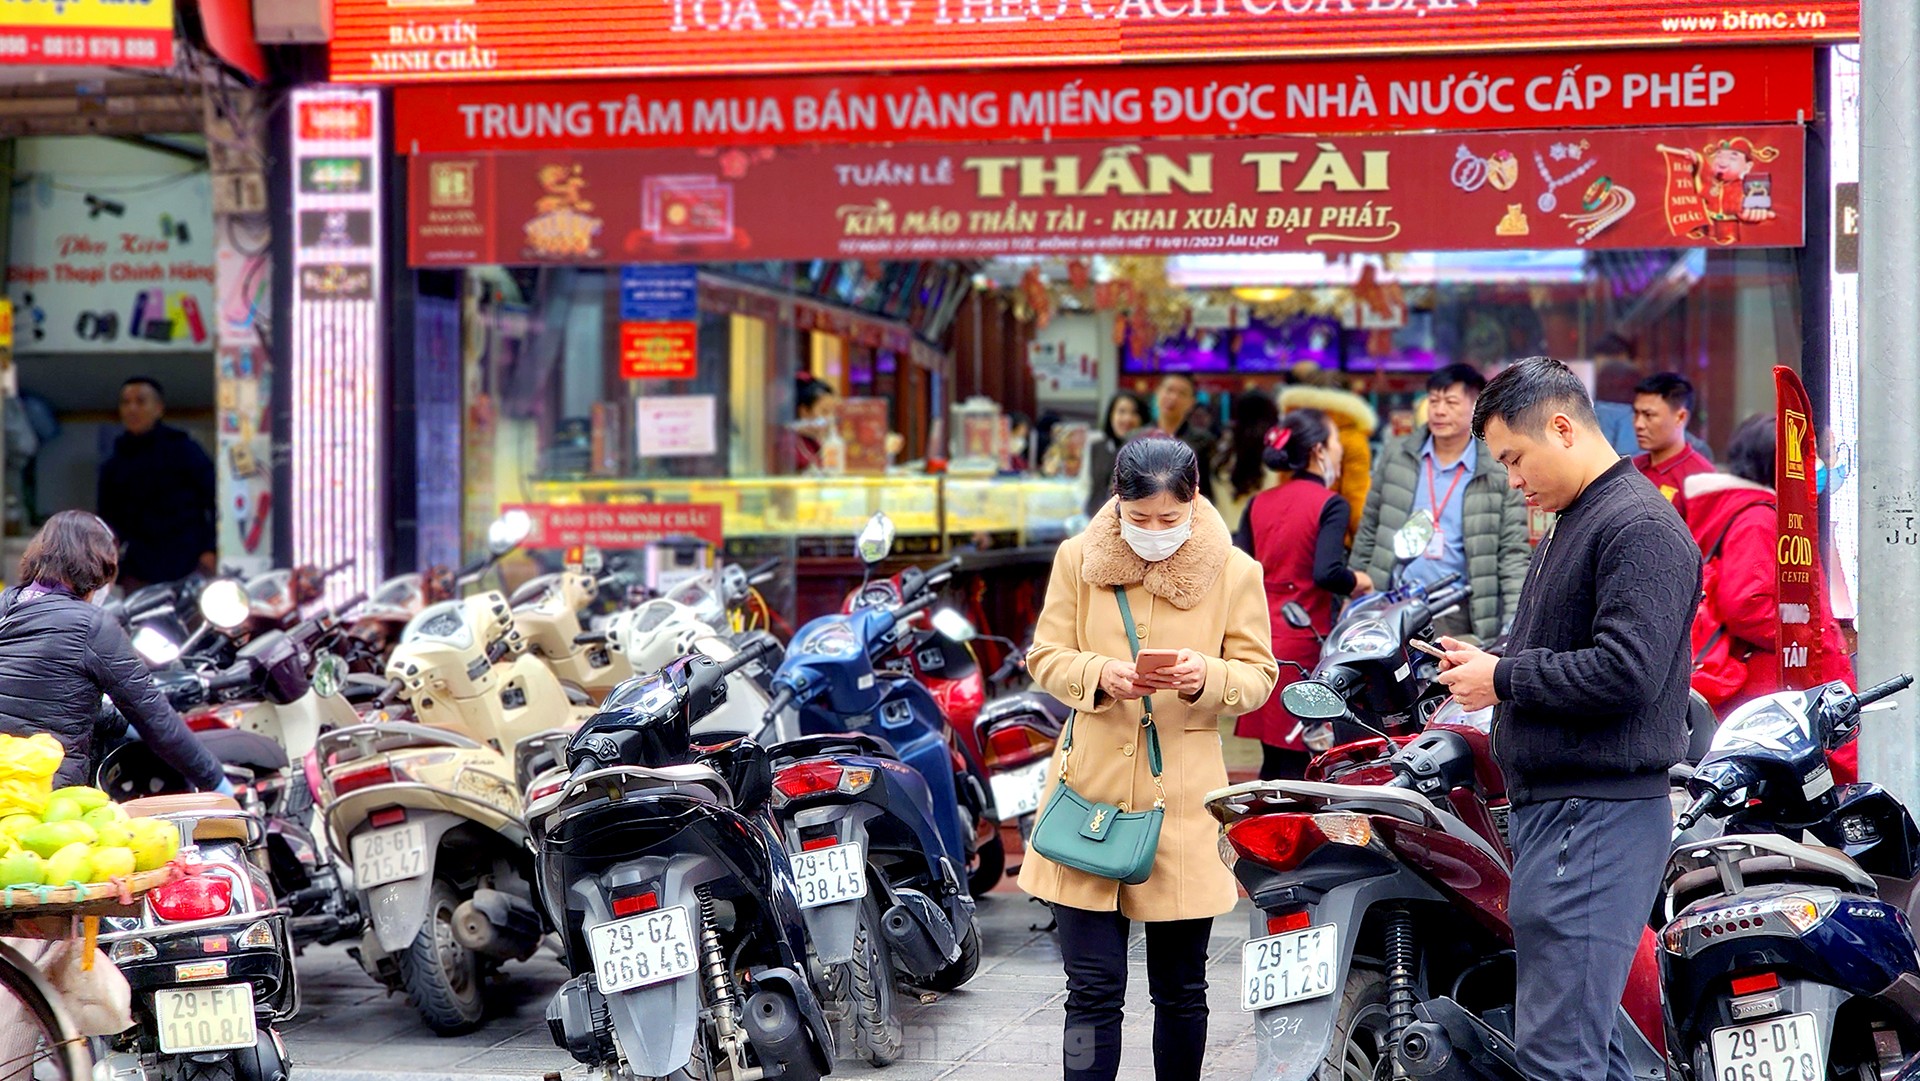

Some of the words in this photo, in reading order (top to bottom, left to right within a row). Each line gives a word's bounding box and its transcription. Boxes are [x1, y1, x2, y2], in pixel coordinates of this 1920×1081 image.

[438, 18, 478, 43] TÍN
[370, 51, 430, 71] MINH
[434, 44, 499, 69] CHÂU
[459, 102, 593, 138] TRUNG
[600, 94, 684, 136] TÂM
[693, 96, 784, 134] MUA
[793, 88, 877, 132] BÁN
[885, 86, 999, 128] VÀNG
[1009, 78, 1142, 126] MIẾNG
[1151, 82, 1275, 130] ĐƯỢC
[1287, 75, 1378, 118] NHÀ
[1390, 71, 1515, 114] NƯỚC
[1525, 64, 1612, 112] CẤP
[1623, 64, 1736, 108] PHÉP
[1241, 141, 1391, 192] TÀI
[1671, 195, 1699, 206] MINH
[1044, 203, 1086, 232] TÀI
[1111, 207, 1177, 231] KHAI
[1184, 201, 1258, 230] XUÂN
[1265, 205, 1312, 233] ĐẠI
[1226, 234, 1248, 247] ÂM
[1249, 235, 1280, 249] LỊCH
[1777, 534, 1812, 567] GOLD
[364, 828, 413, 860] 28-G1
[360, 850, 421, 884] 215.47
[794, 847, 850, 880] 29-C1
[606, 913, 677, 955] 29-G2
[603, 942, 689, 987] 068.46
[171, 988, 238, 1019] 29-F1
[168, 1017, 250, 1048] 110.84
[1728, 1020, 1801, 1061] 29-D1
